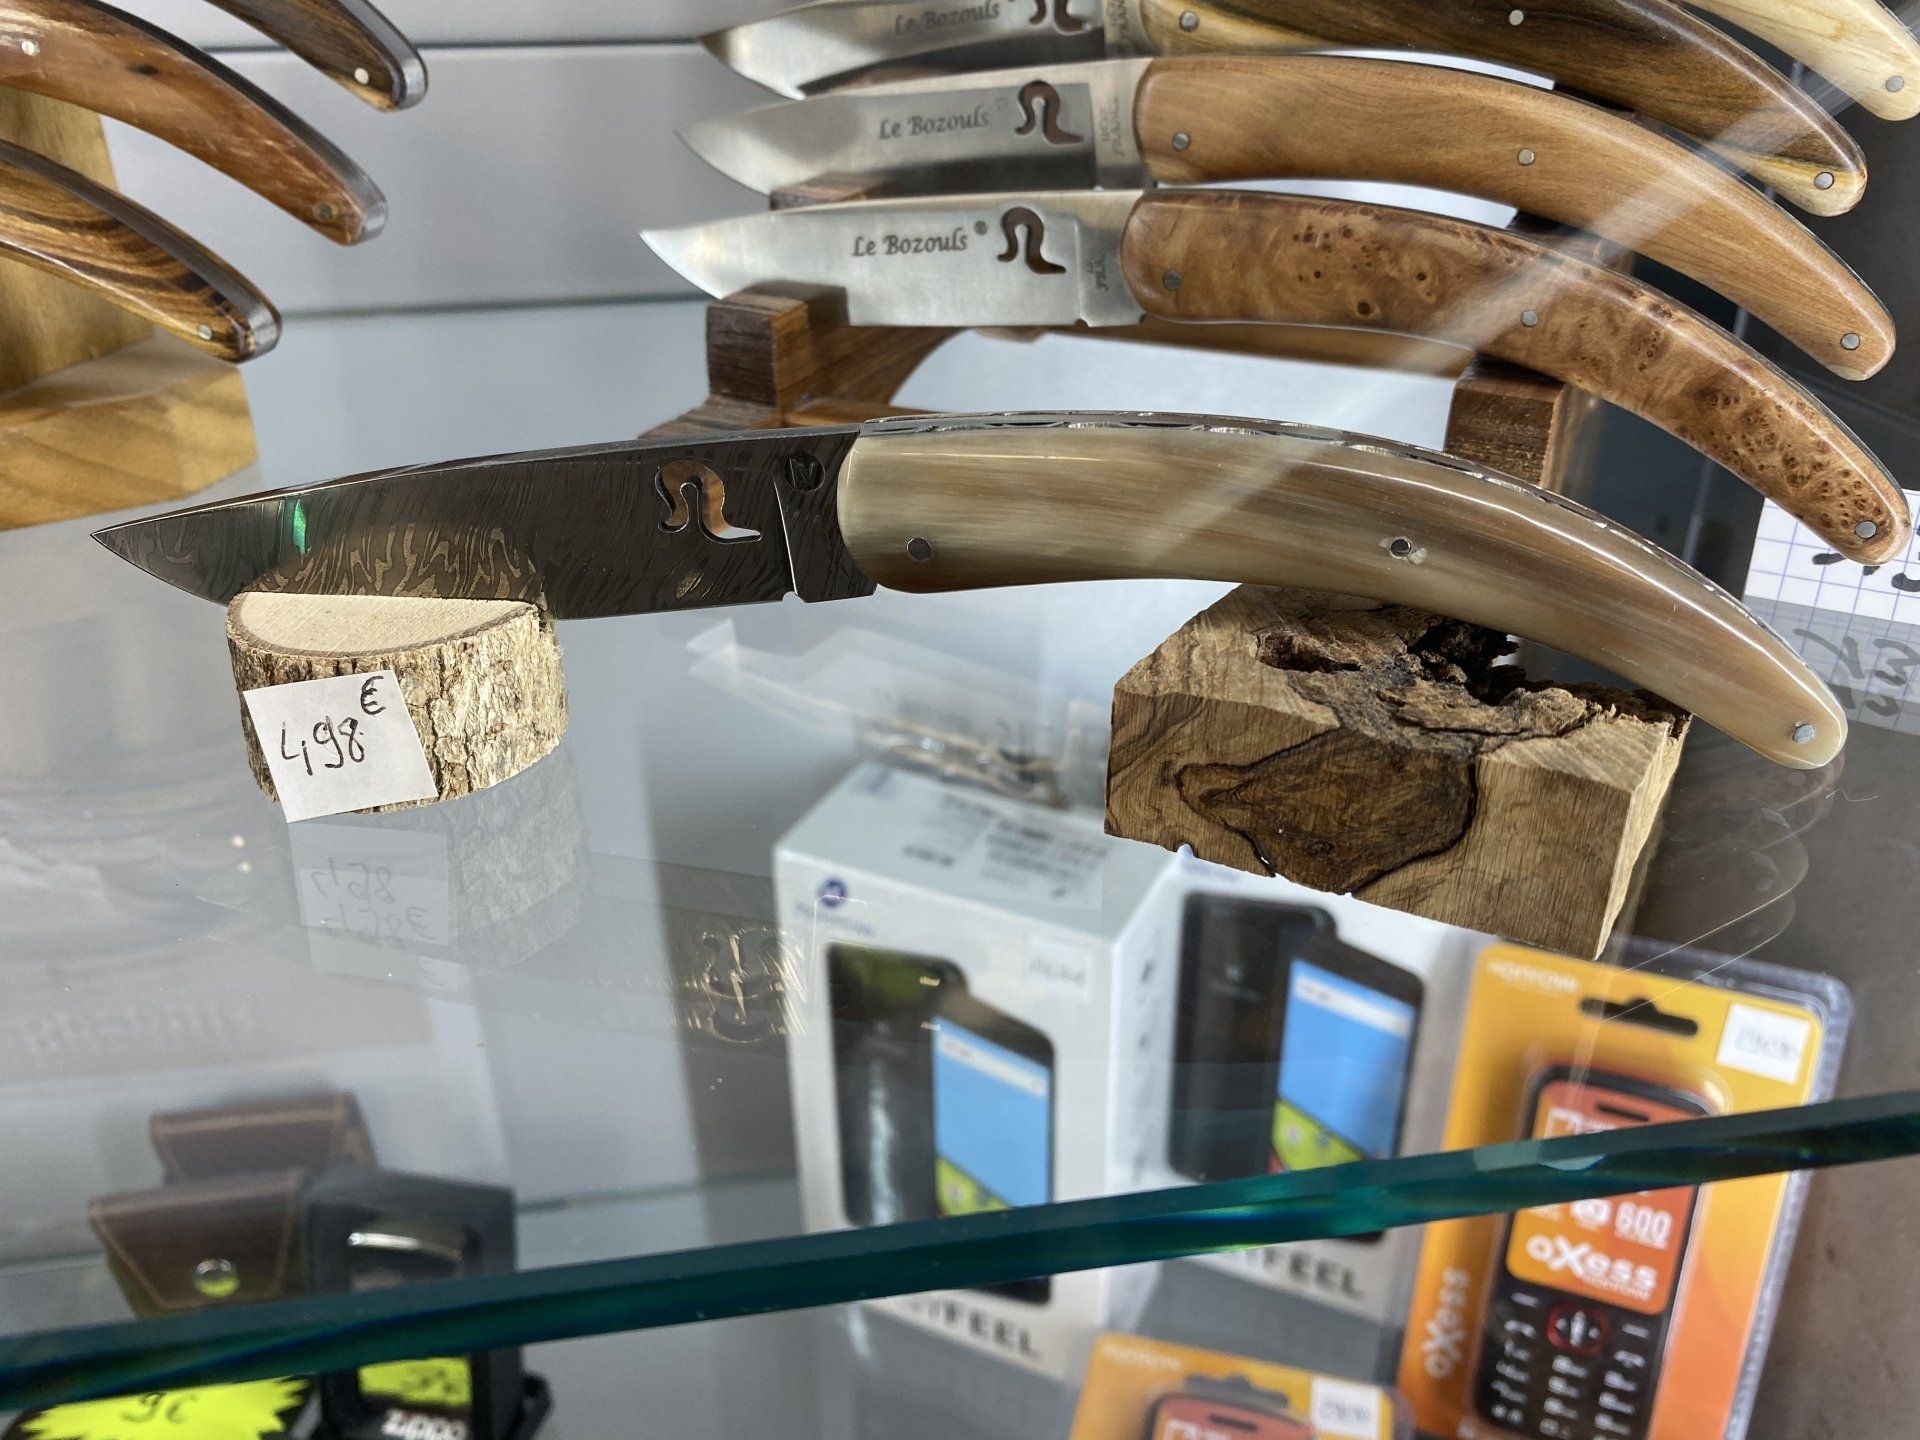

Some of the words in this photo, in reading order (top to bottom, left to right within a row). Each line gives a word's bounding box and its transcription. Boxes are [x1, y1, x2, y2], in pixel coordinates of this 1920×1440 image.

[878, 117, 902, 140] Le
[907, 105, 990, 136] Bozouls
[852, 235, 876, 257] Le
[884, 226, 968, 256] Bozouls
[1615, 1200, 1673, 1242] 600
